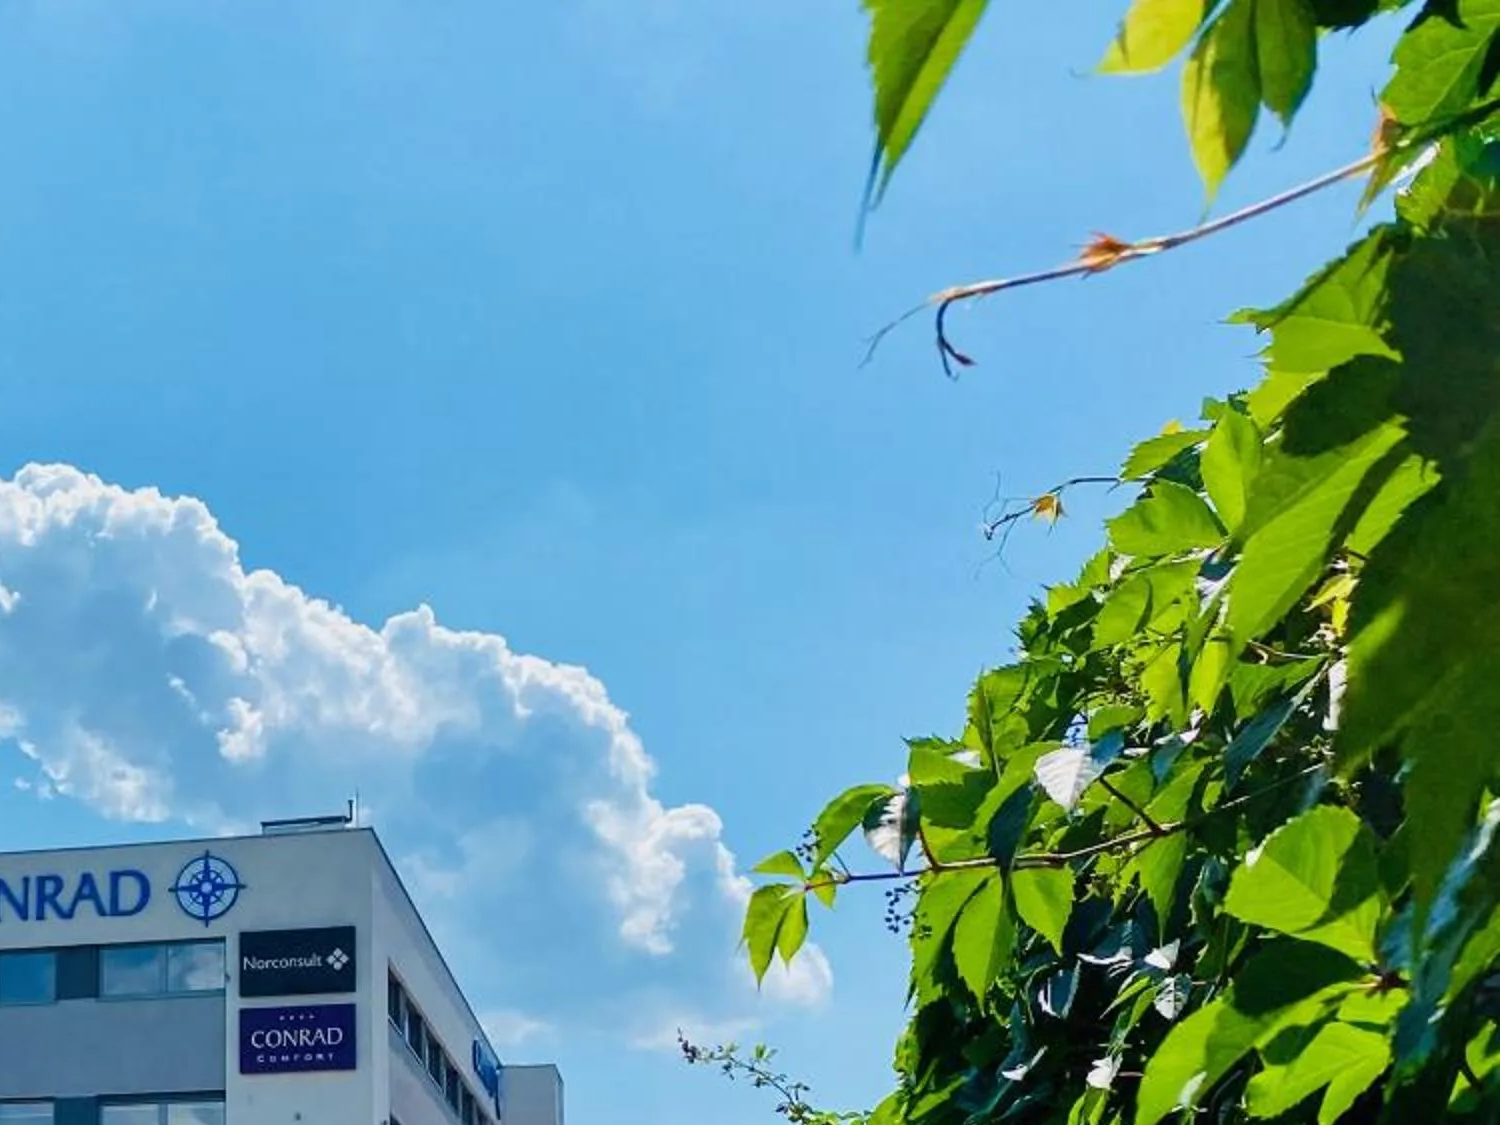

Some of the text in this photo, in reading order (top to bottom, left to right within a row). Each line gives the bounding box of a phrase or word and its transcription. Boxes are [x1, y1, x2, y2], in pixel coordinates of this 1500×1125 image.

[243, 952, 322, 971] Norconsult
[251, 1027, 343, 1049] CONRAD
[257, 1052, 334, 1063] COMFORT
